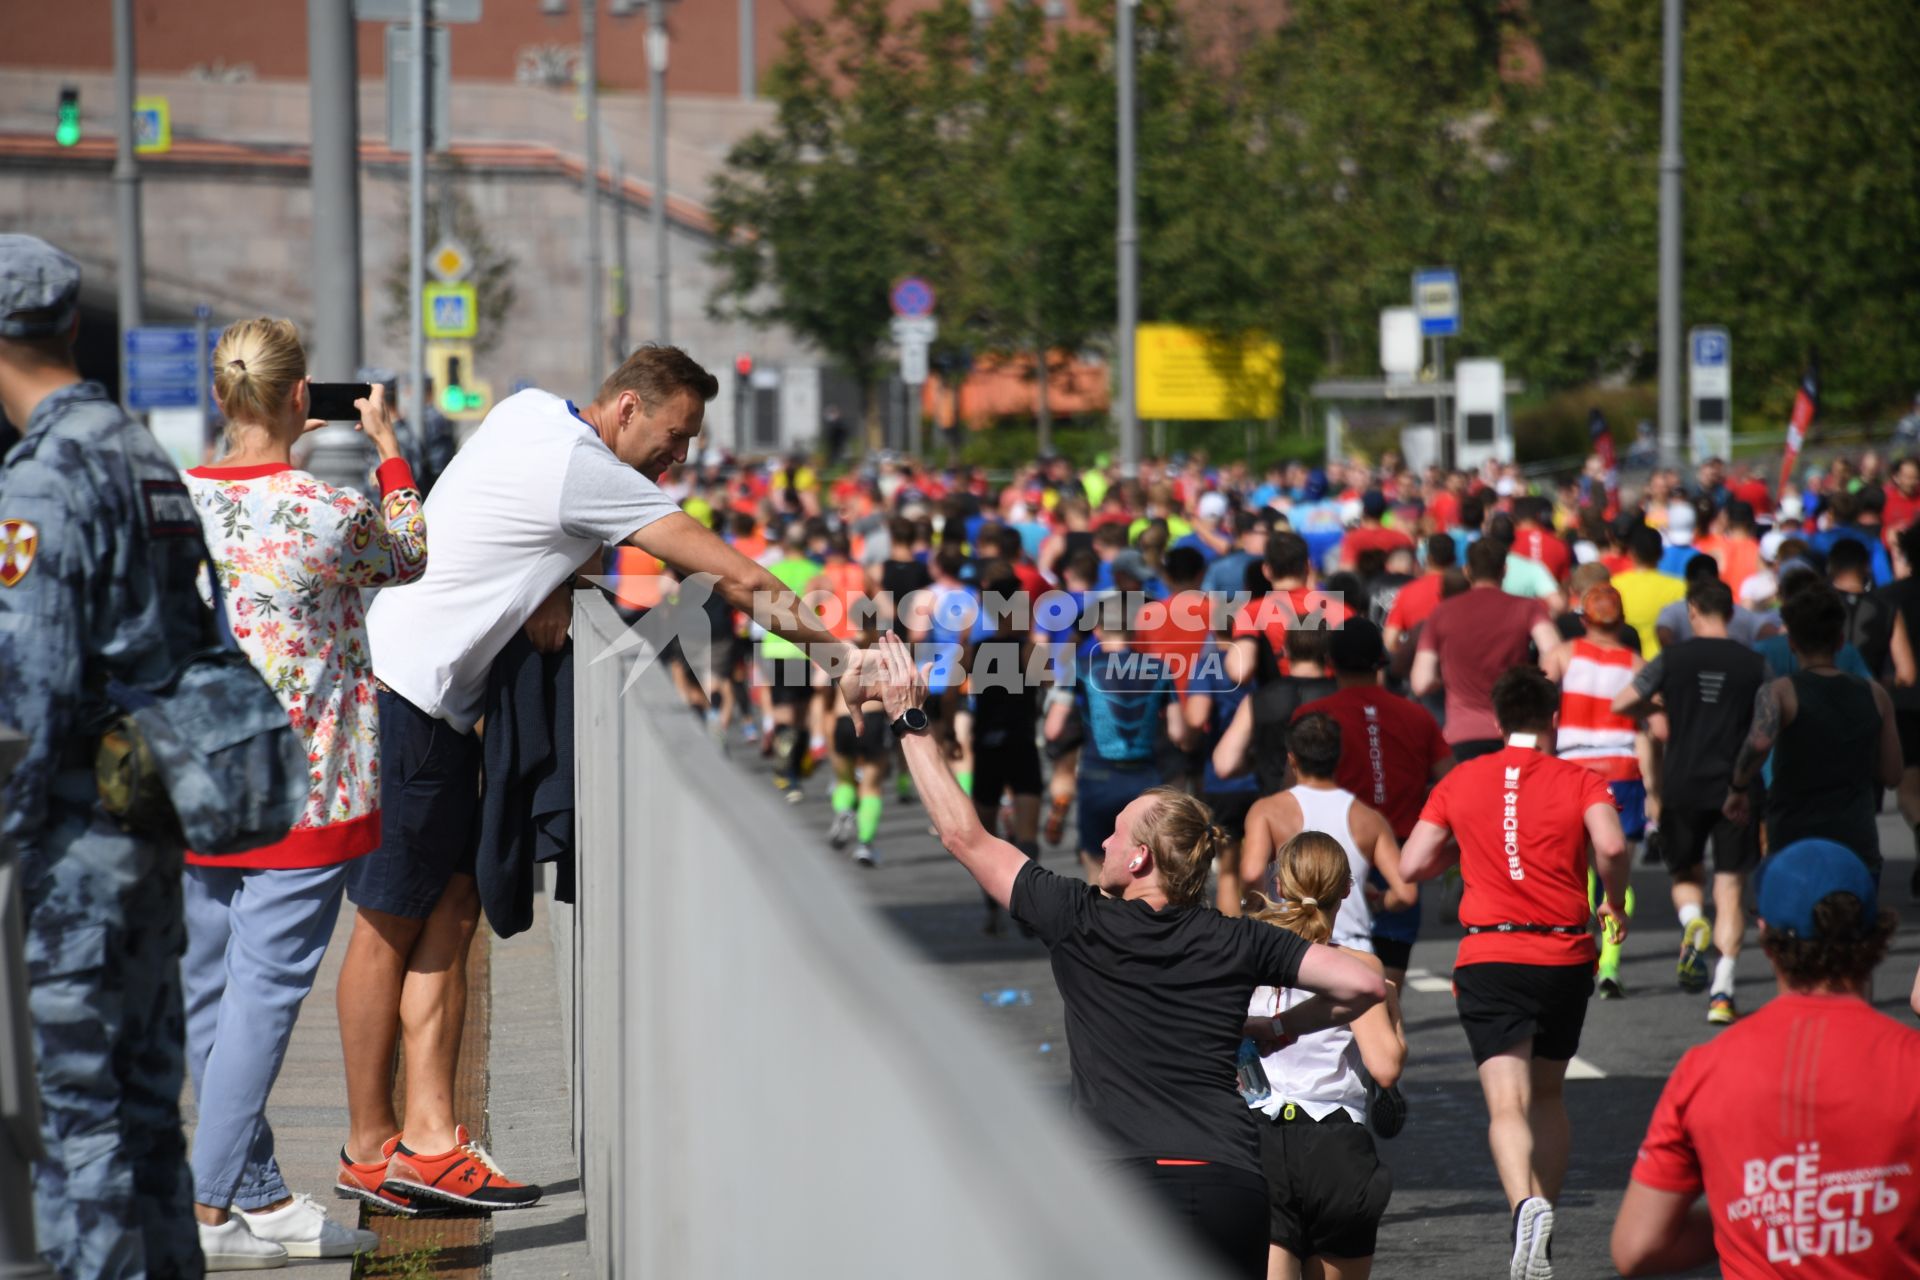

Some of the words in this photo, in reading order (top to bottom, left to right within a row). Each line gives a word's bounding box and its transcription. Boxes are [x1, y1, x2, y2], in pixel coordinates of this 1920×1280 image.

[1744, 1142, 1820, 1196] ВСЁ
[1727, 1192, 1792, 1222] КОГДА
[1794, 1180, 1900, 1224] ЕСТЬ
[1767, 1218, 1873, 1266] ЦЕЛЬ
